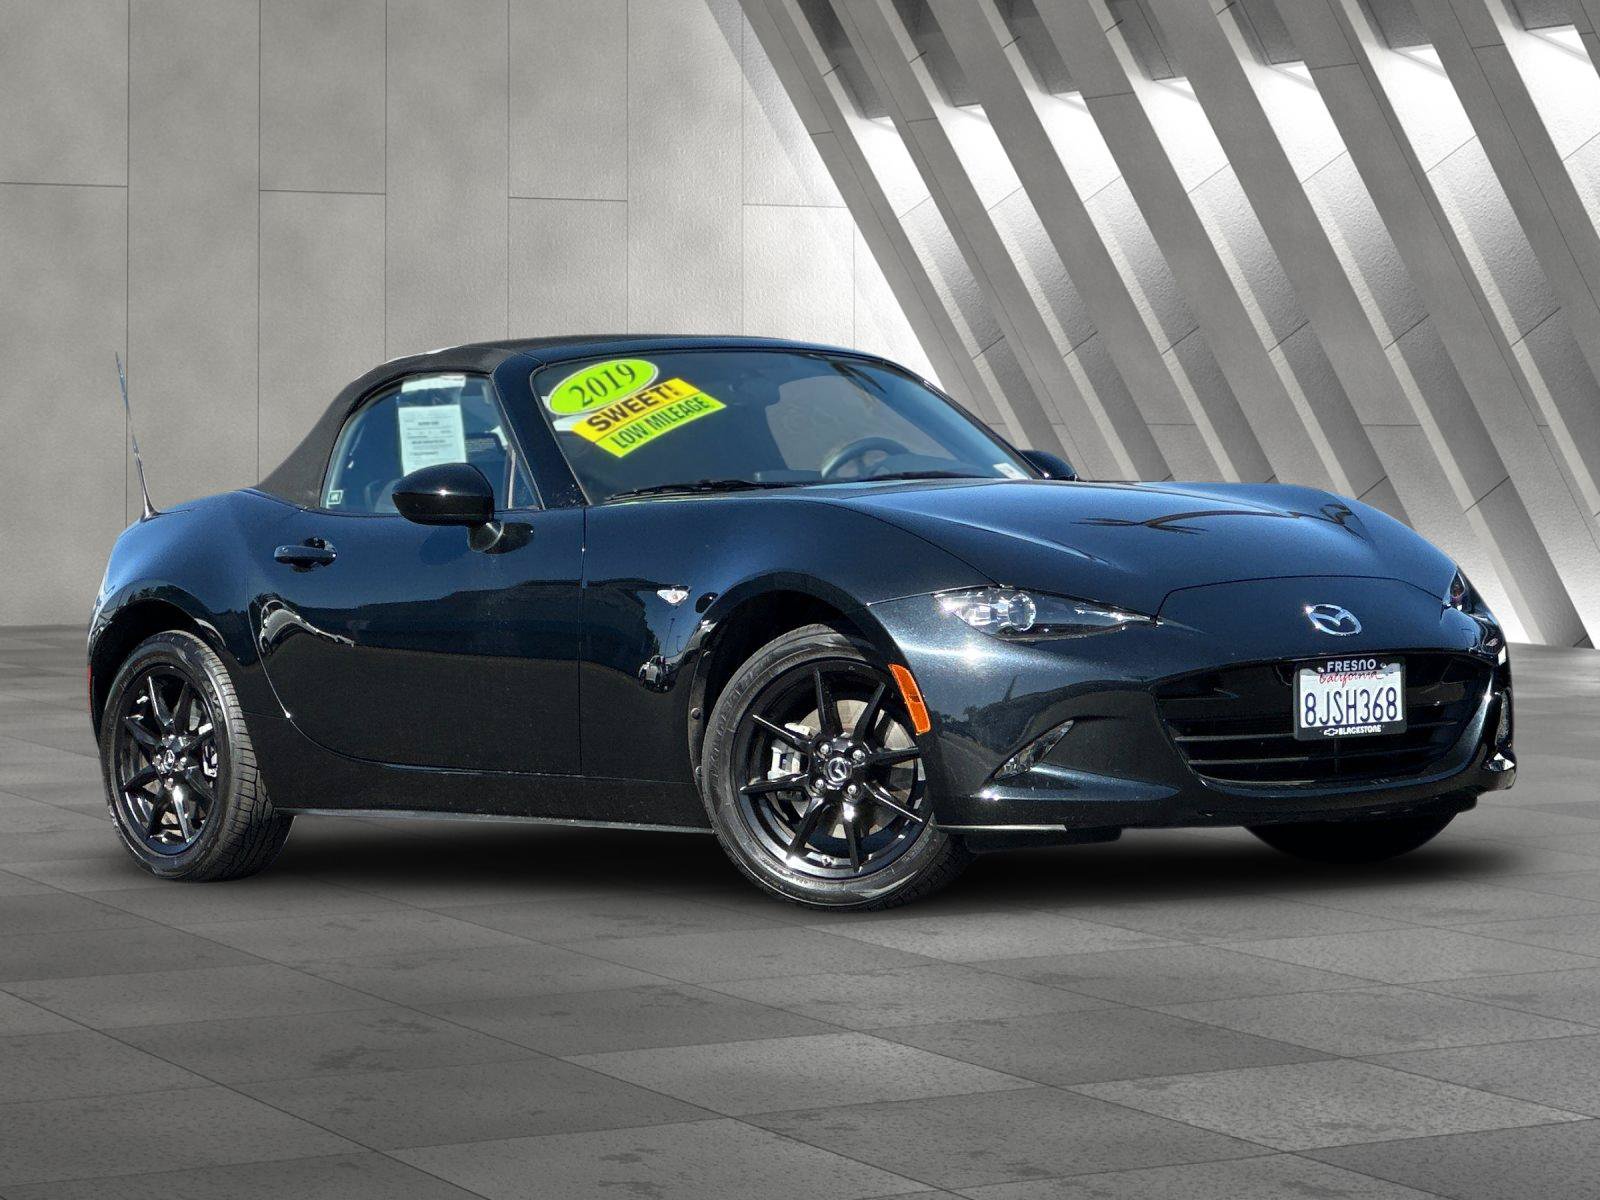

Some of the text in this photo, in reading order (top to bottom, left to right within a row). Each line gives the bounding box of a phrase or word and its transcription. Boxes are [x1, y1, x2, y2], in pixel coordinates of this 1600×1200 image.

[569, 362, 637, 408] 2019
[587, 384, 680, 432] SWEET!
[611, 396, 711, 450] LOW MILEAGE
[1327, 659, 1377, 673] FRESNO
[1304, 686, 1398, 727] 8JSH368
